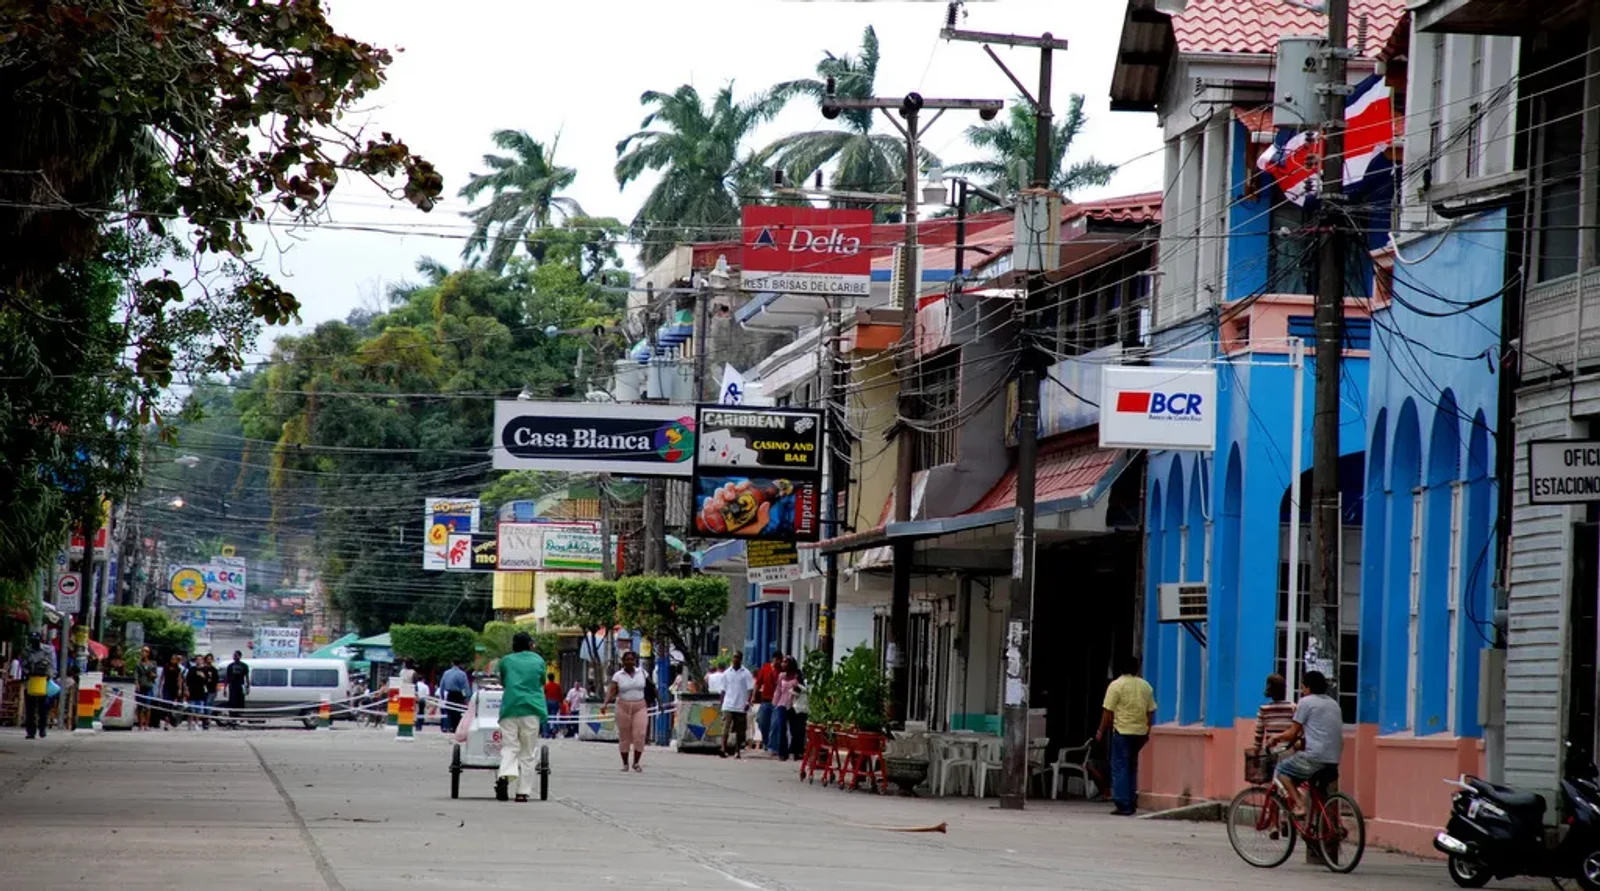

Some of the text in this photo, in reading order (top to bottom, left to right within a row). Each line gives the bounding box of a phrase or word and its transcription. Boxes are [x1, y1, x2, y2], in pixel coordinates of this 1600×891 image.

[788, 229, 861, 255] Delta
[772, 280, 807, 291] BRISAS
[810, 281, 828, 291] DEL
[831, 282, 867, 293] CARIBE
[1150, 392, 1203, 415] BCR
[704, 413, 786, 429] CARIBBEAN
[513, 427, 651, 452] Casa Blanca
[753, 440, 814, 452] CASINO AND
[784, 453, 807, 463] BAR
[796, 481, 815, 534] Imperial
